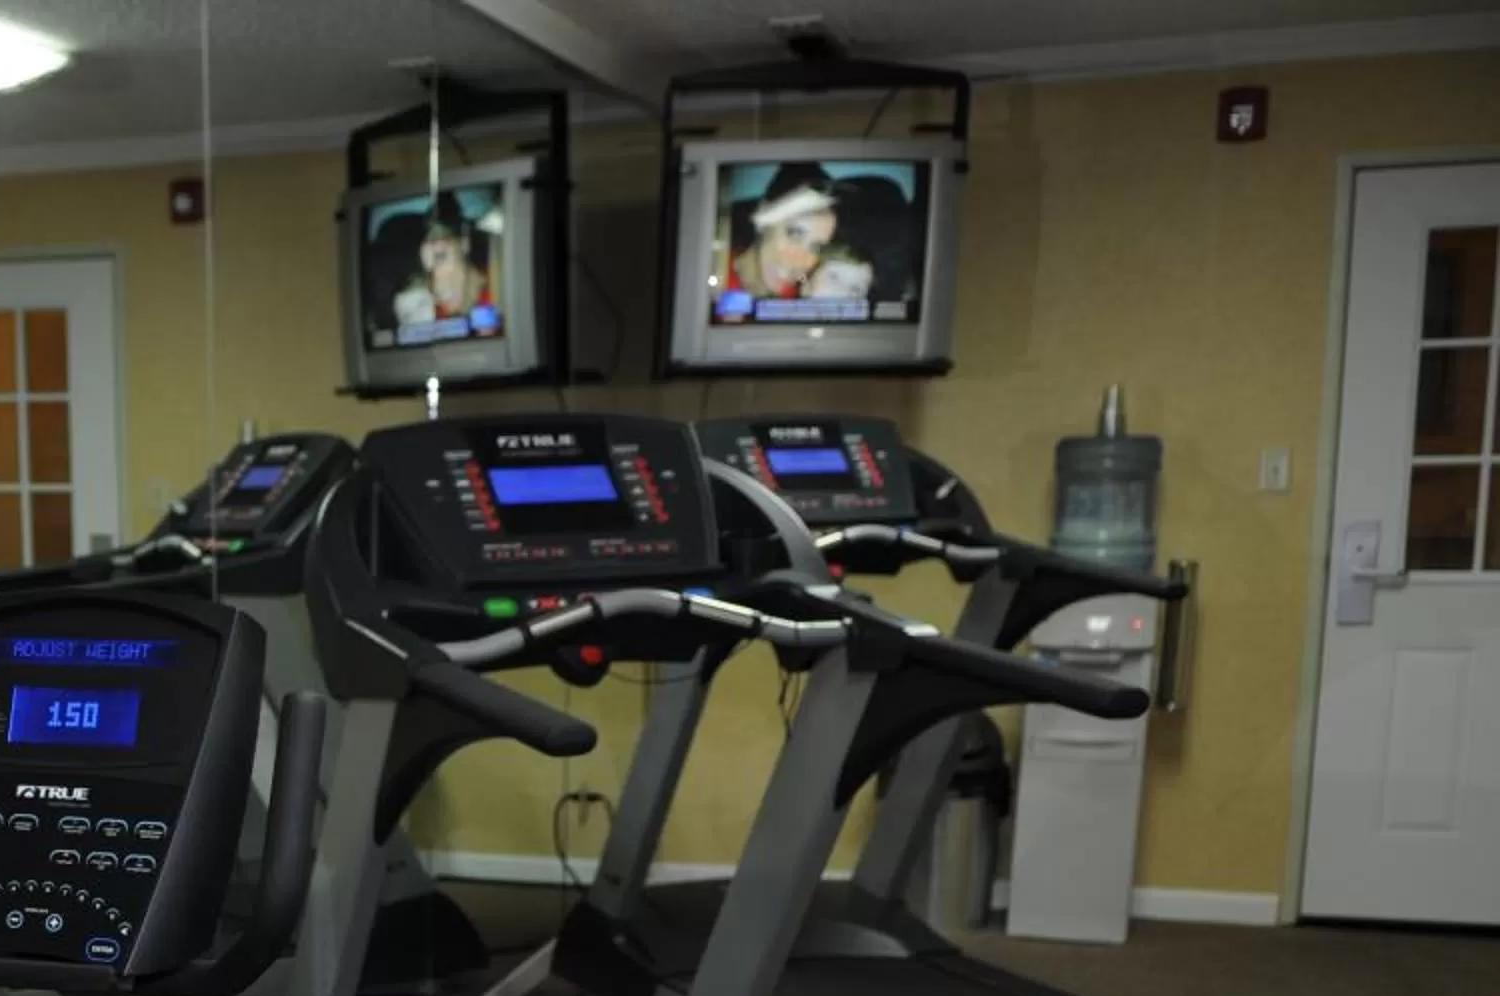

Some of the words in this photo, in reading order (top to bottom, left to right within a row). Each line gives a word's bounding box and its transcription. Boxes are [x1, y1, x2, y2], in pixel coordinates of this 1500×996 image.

[12, 640, 75, 657] ADJUST
[85, 642, 153, 660] WEIGHT
[46, 700, 100, 729] 150
[37, 785, 93, 801] TRUE
